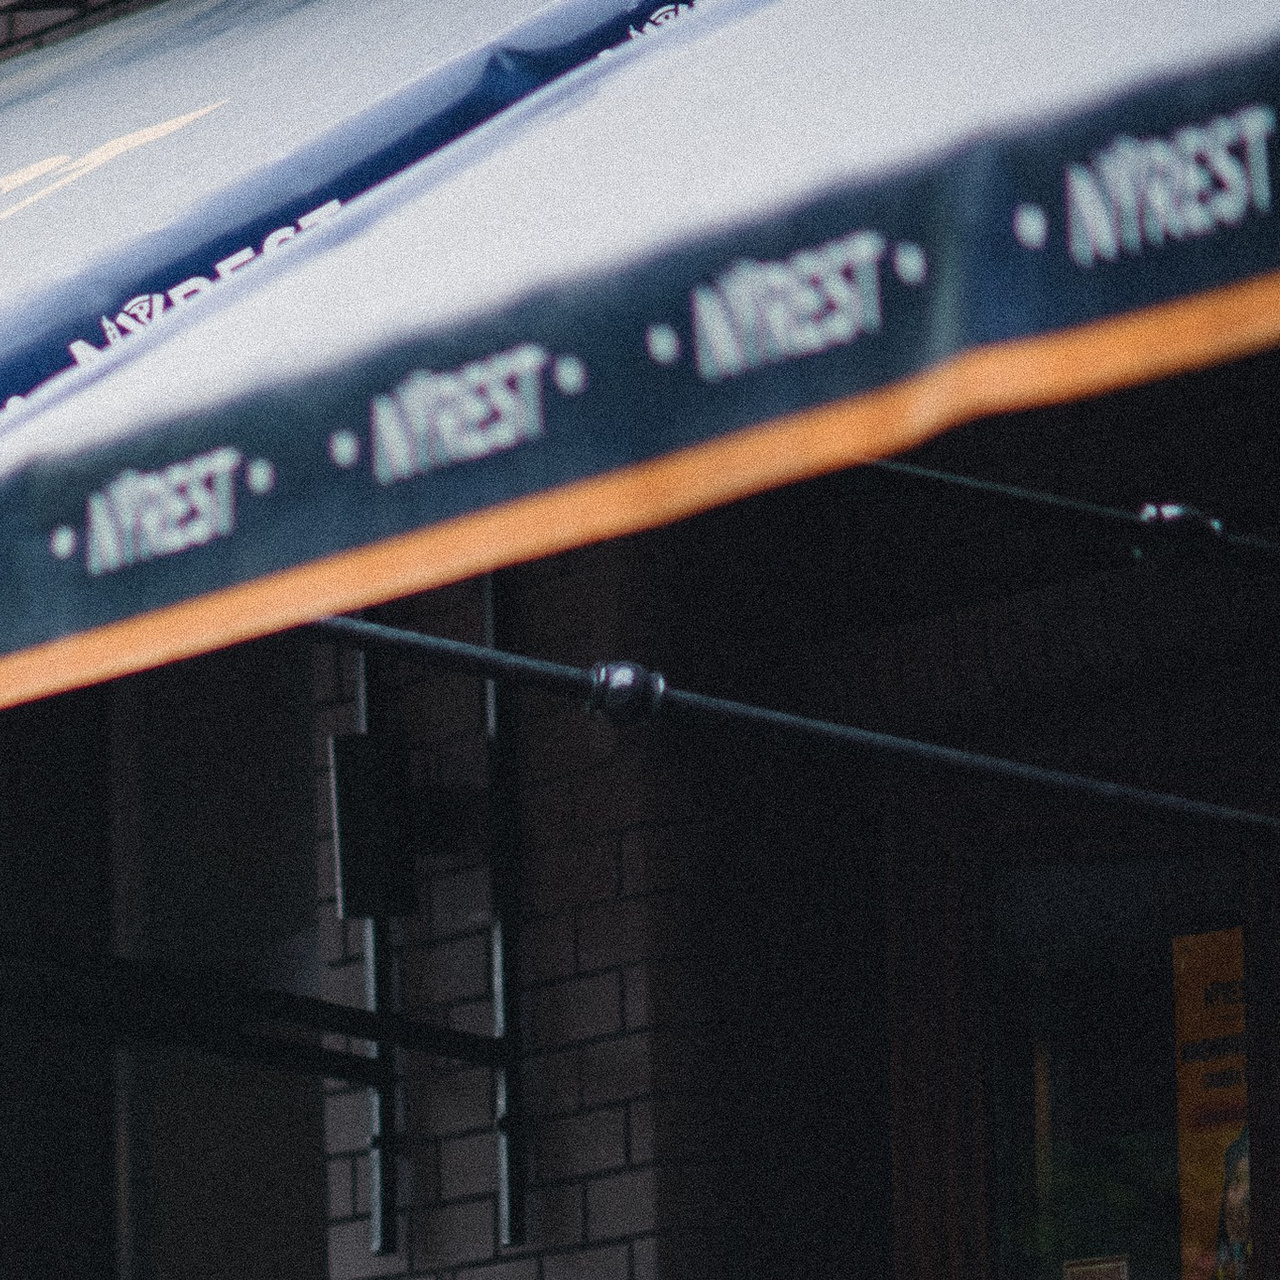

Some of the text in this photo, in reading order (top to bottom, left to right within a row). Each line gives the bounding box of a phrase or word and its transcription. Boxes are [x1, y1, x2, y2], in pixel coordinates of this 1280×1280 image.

[87, 446, 239, 576] NYREST
[372, 343, 546, 485] NYREST
[692, 230, 885, 382] NYREST
[1065, 104, 1277, 268] NYREST
